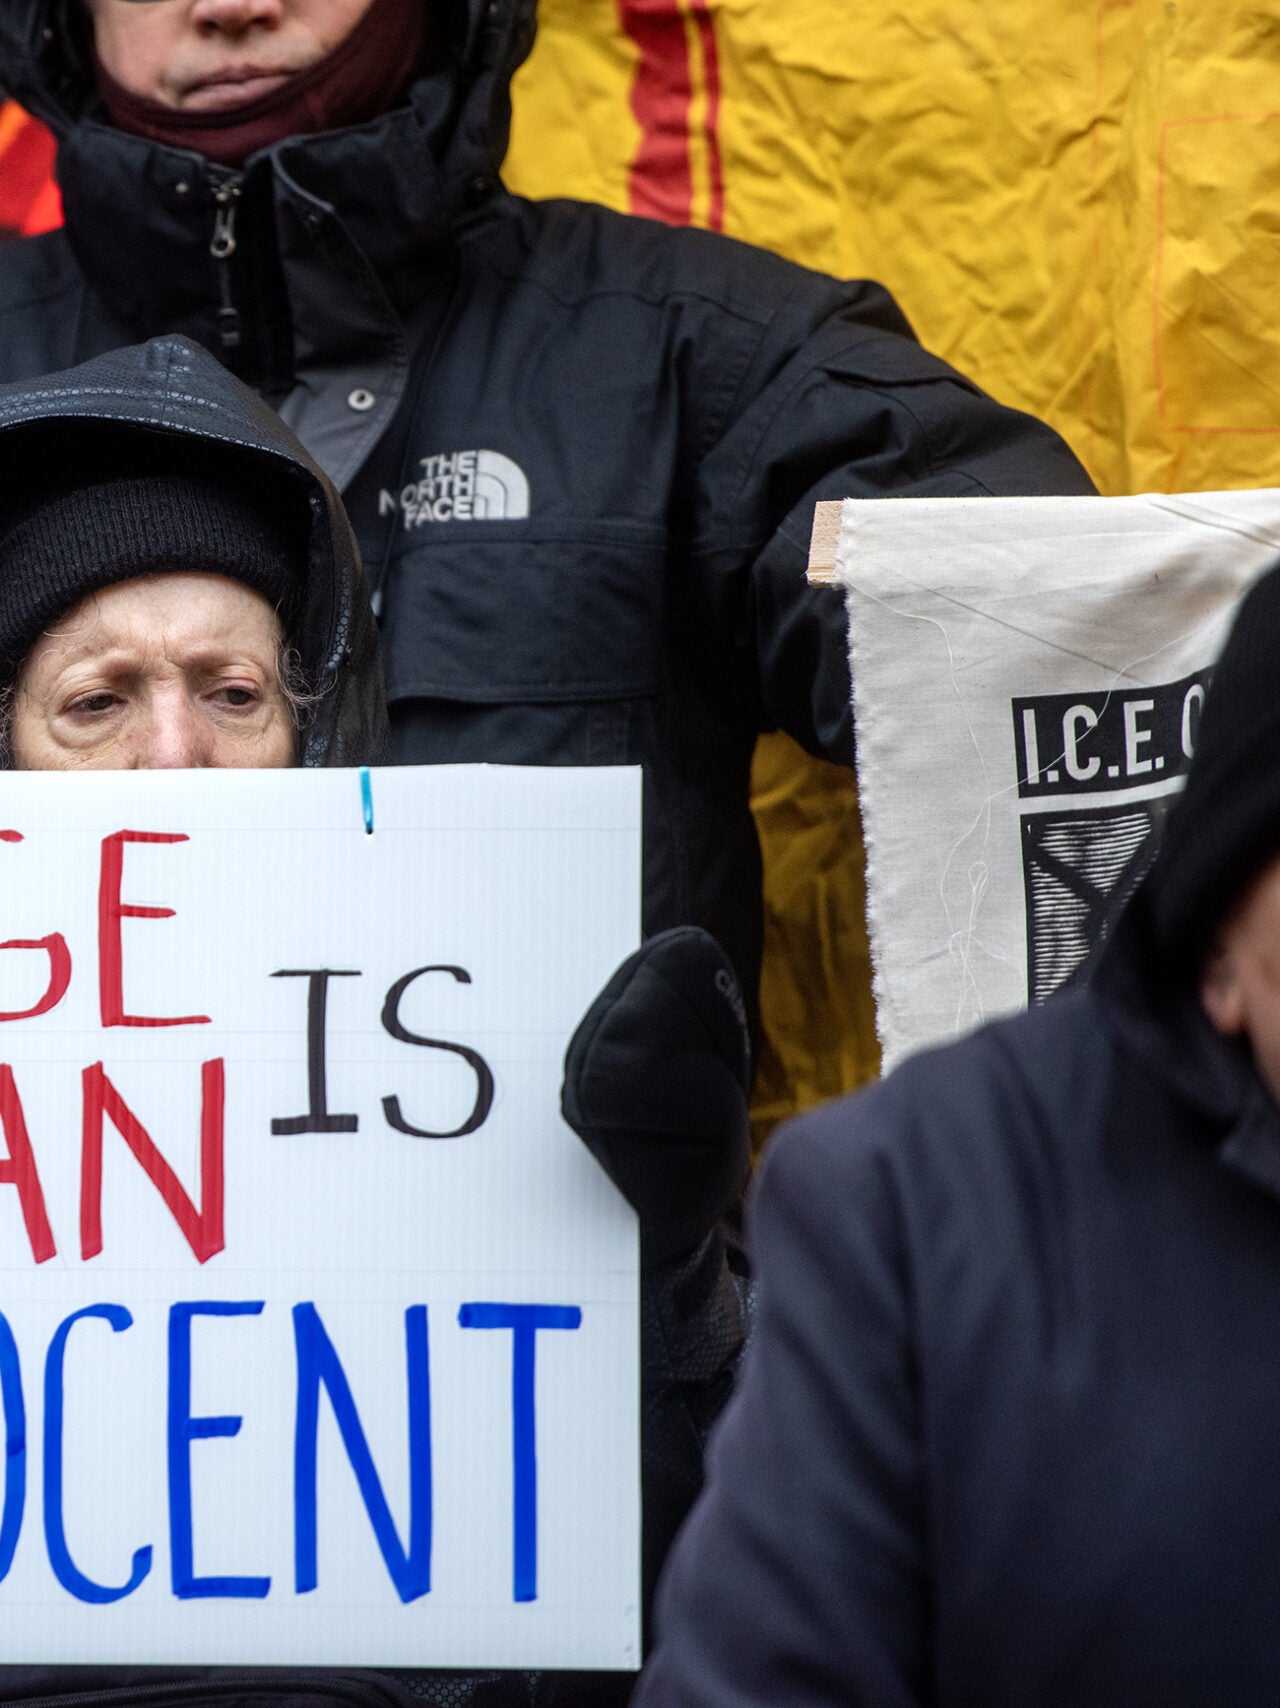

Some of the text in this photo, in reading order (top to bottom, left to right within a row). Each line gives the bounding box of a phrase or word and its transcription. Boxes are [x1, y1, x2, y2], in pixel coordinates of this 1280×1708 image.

[420, 450, 477, 479] THE
[378, 473, 475, 516] NORTH
[404, 496, 474, 531] FACE
[1021, 699, 1166, 786] I.C.E.
[270, 964, 495, 1140] IS
